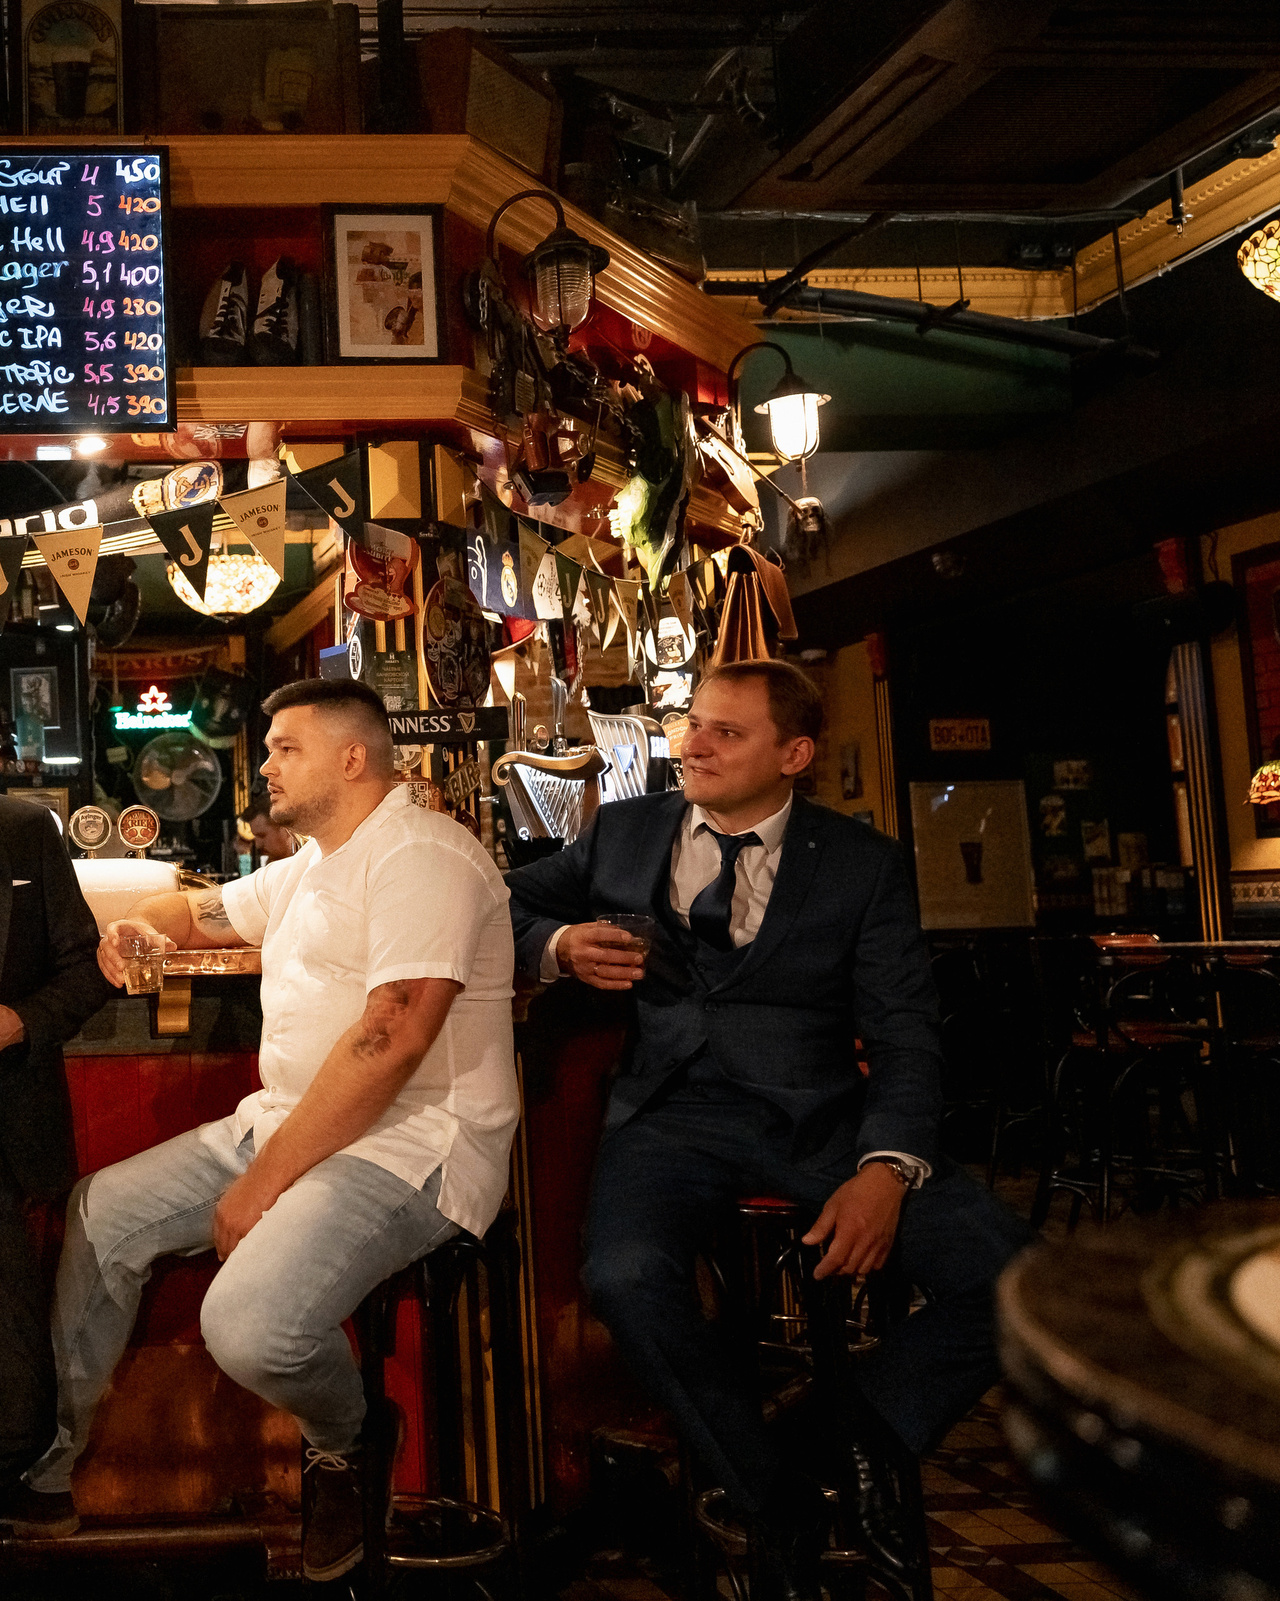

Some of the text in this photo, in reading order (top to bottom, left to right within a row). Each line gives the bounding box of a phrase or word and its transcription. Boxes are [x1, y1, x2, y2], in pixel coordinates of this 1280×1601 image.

[81, 164, 99, 185] 4
[116, 158, 160, 183] 450
[87, 194, 104, 216] 5
[119, 195, 161, 215] 420
[118, 230, 158, 251] 420
[120, 262, 160, 286] 400
[123, 297, 161, 316] 280
[17, 325, 62, 349] IPA
[124, 331, 162, 351] 420
[123, 364, 164, 384] 390
[126, 395, 166, 415] 390
[328, 478, 356, 520] J
[240, 504, 279, 522] JAMESON
[51, 548, 93, 562] JAMESON
[179, 524, 203, 567] J
[388, 715, 451, 734] INNESS
